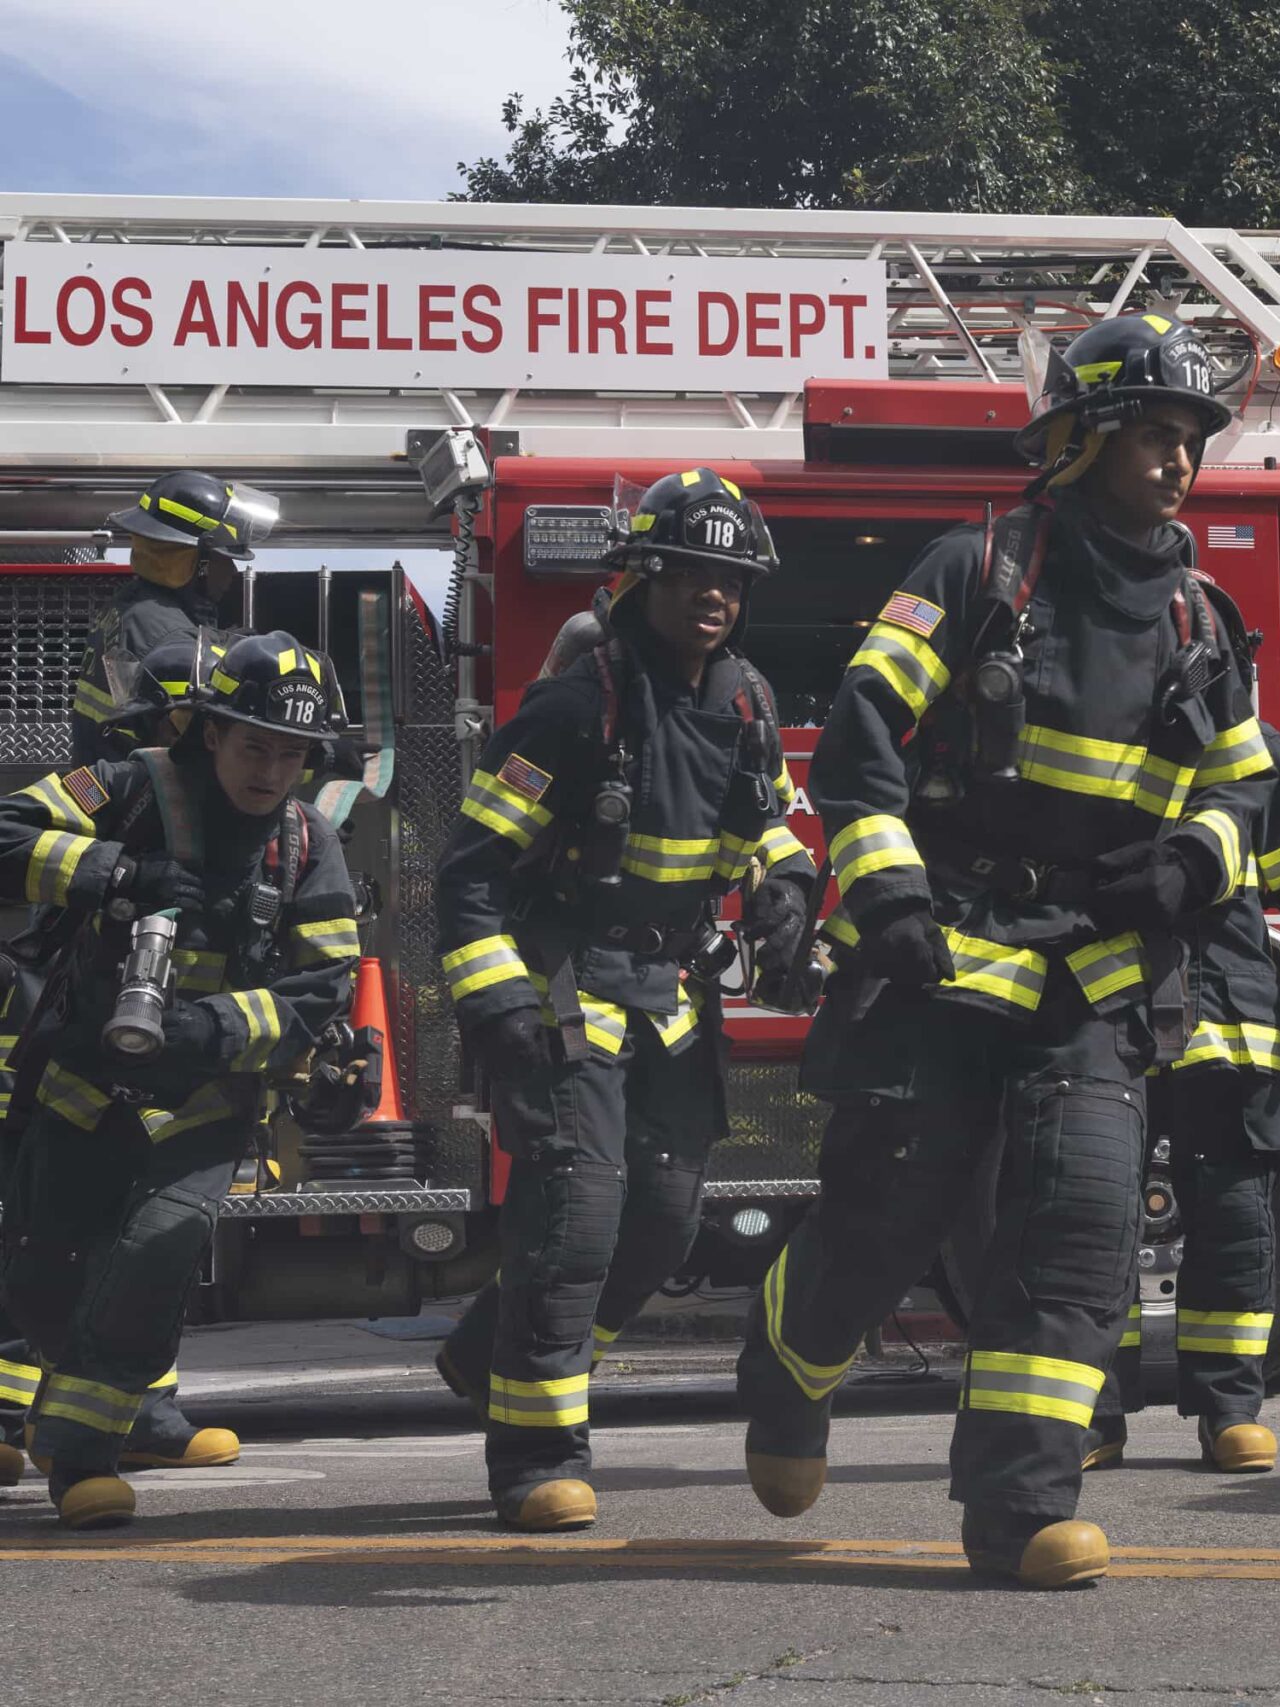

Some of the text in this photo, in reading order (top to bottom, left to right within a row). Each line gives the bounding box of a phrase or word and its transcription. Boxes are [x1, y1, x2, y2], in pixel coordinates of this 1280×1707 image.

[13, 275, 878, 361] LOS ANGELES FIRE DEPT.
[1182, 360, 1211, 394] 118
[688, 505, 746, 532] LOS ANGELES
[704, 518, 736, 549] 118
[277, 683, 325, 706] LOS ANGELES
[283, 698, 316, 725] 118
